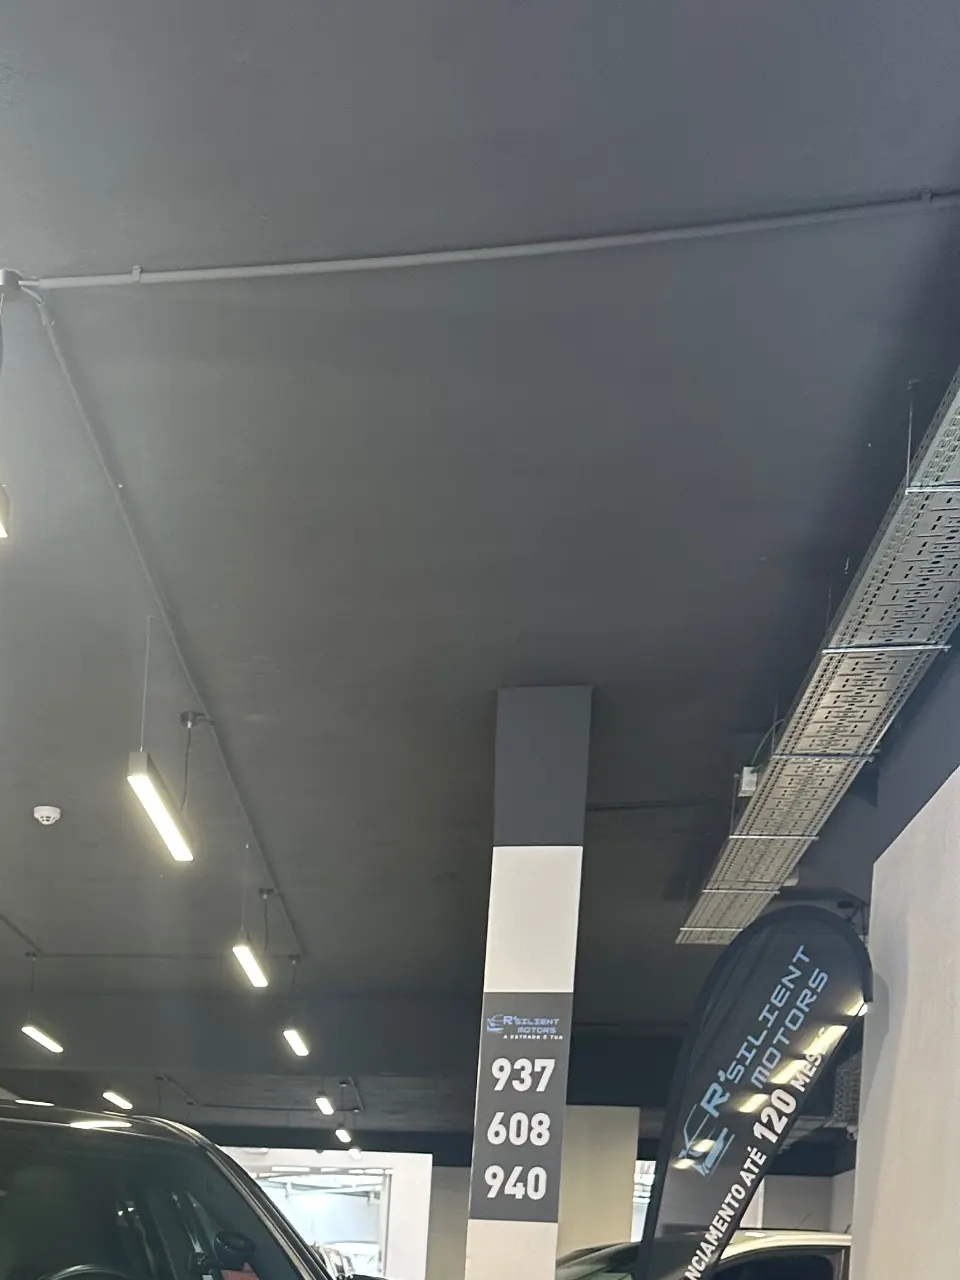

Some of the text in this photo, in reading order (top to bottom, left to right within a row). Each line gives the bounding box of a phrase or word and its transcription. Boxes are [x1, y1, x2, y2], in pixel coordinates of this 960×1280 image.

[750, 968, 828, 1089] MOTORS
[491, 1057, 556, 1092] 937
[487, 1111, 551, 1146] 608
[739, 1145, 767, 1187] ATÉ
[753, 1088, 797, 1144] 120
[484, 1164, 547, 1201] 940
